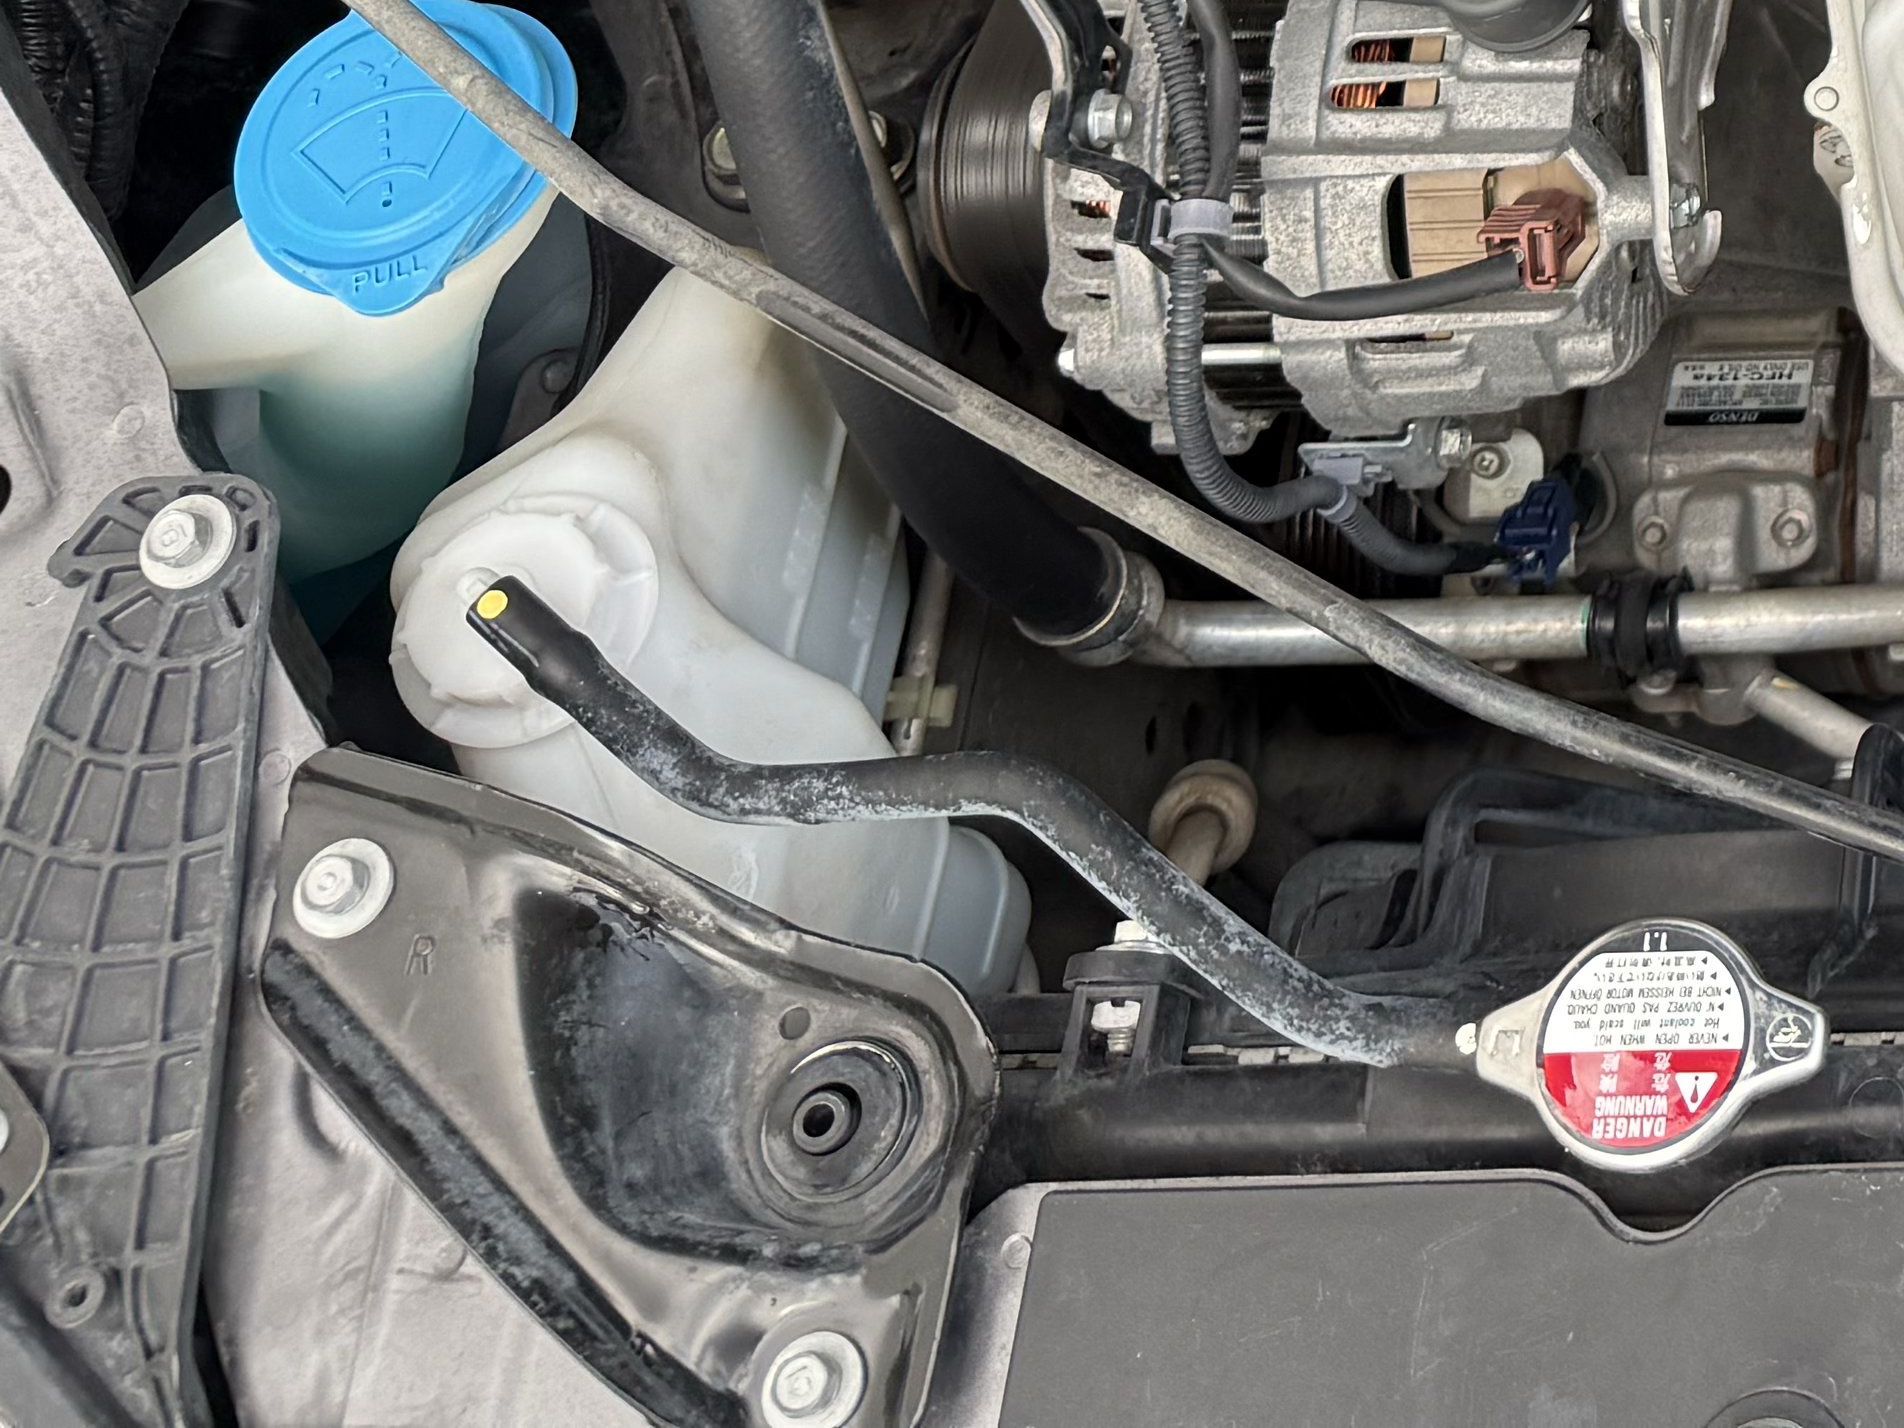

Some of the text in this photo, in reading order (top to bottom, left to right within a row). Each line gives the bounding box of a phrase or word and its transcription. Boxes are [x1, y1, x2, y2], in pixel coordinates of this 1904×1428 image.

[352, 254, 428, 296] PULL
[1692, 370, 1794, 382] HFC-134a
[1708, 410, 1760, 422] DENSO
[1642, 932, 1668, 952] 1.1
[406, 934, 434, 976] R
[1606, 988, 1634, 1000] MOTOR
[1638, 986, 1674, 1000] HEISSEM
[1678, 986, 1692, 998] BEI
[1696, 986, 1722, 998] NICHT
[1604, 1004, 1636, 1016] QUAND
[1642, 1002, 1660, 1014] PAS
[1598, 1020, 1624, 1032] scald
[1634, 1020, 1652, 1030] will
[1660, 1018, 1696, 1030] coolant
[1704, 1018, 1720, 1030] Hot
[1620, 1034, 1646, 1046] WHEN
[1656, 1032, 1680, 1046] OPEN
[1688, 1032, 1718, 1046] NEVER
[1594, 1094, 1670, 1118] WARNUNG
[1590, 1116, 1668, 1140] DANGER
